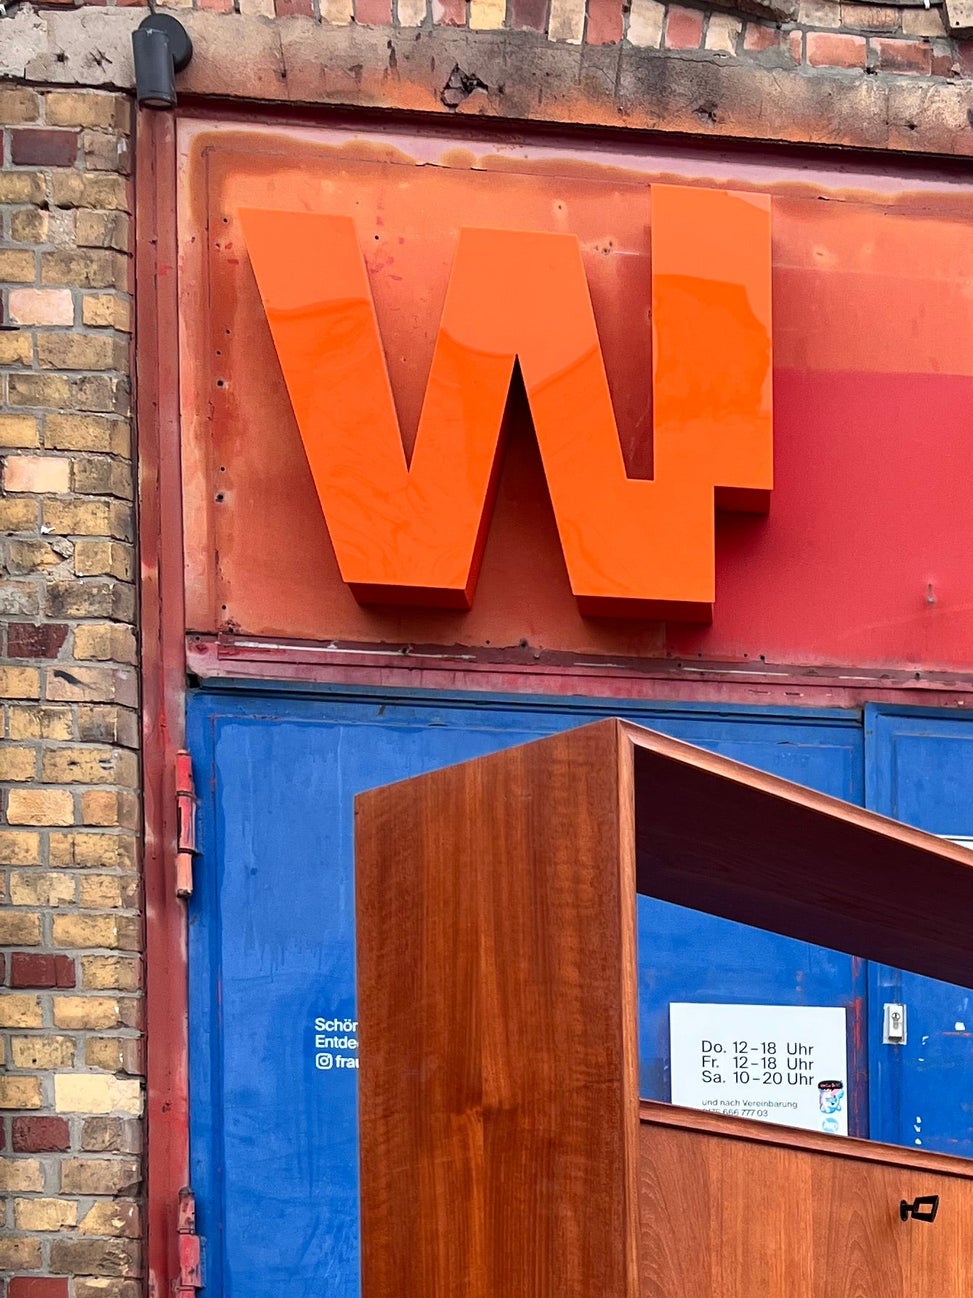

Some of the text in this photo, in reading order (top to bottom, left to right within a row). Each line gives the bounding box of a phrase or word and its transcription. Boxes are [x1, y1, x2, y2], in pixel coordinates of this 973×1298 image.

[315, 1035, 359, 1049] Entde
[702, 1040, 727, 1054] Do.
[786, 1042, 814, 1056] Uhr
[702, 1055, 719, 1068] Fr.
[787, 1057, 814, 1071] Uhr
[702, 1070, 726, 1083] Sa.
[787, 1072, 814, 1086] Uhr
[720, 1099, 740, 1107] nach
[742, 1100, 798, 1110] Vereinbarung
